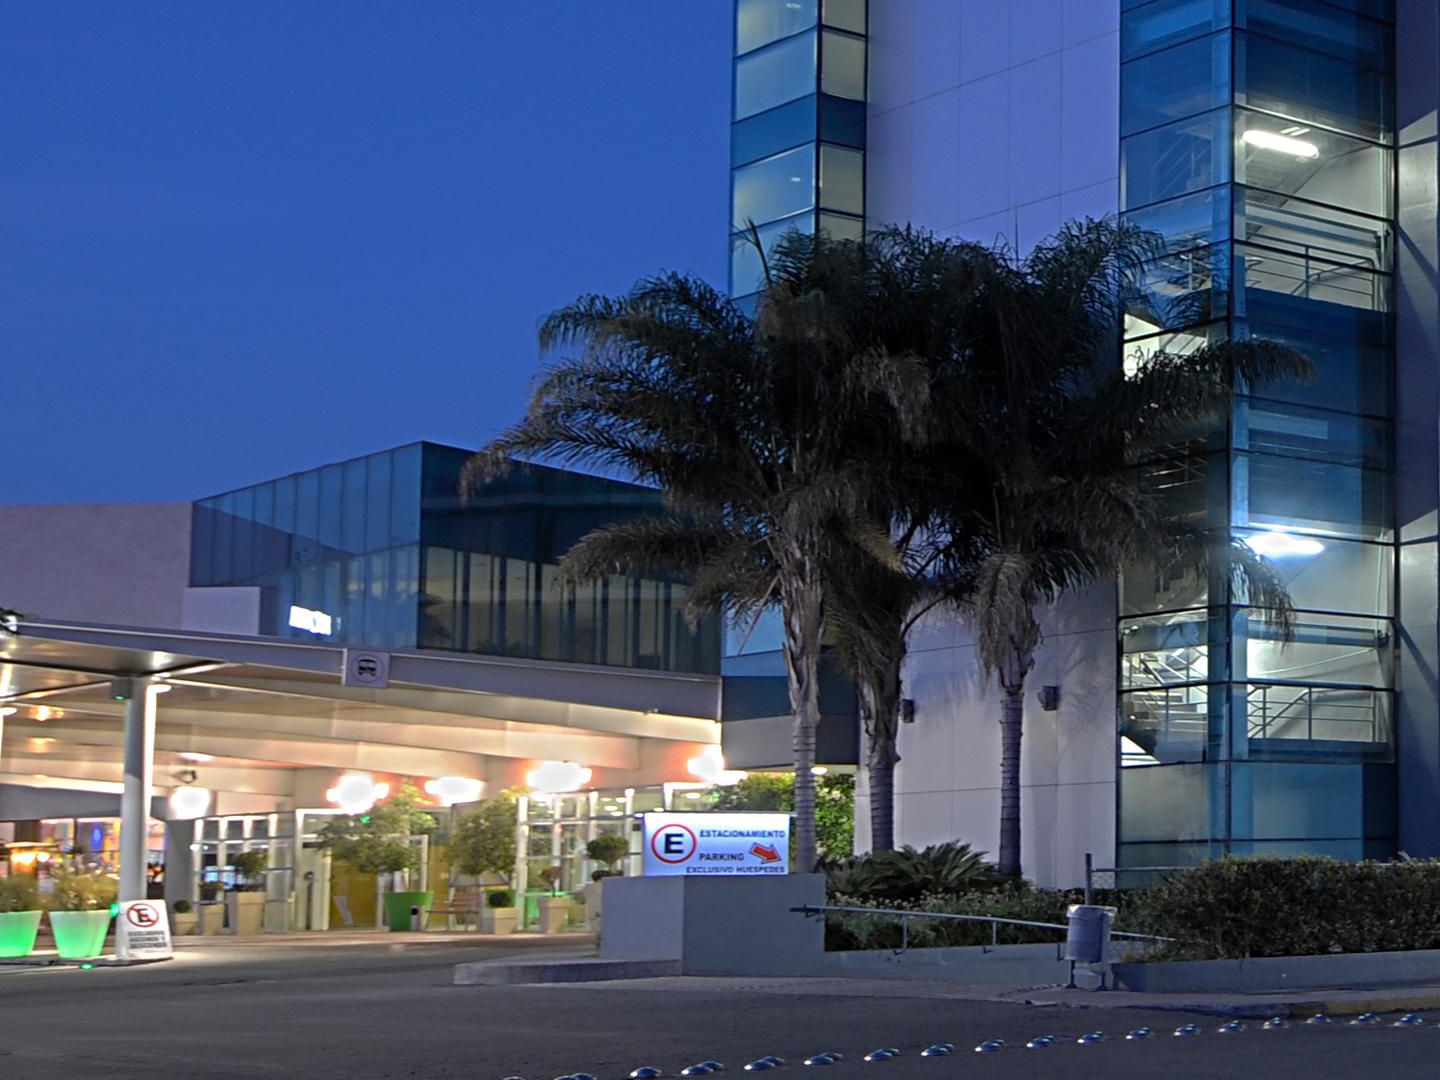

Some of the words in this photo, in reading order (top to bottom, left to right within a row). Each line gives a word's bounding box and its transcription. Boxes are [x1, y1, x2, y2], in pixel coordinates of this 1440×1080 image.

[700, 829, 786, 838] ESTACIONAMIENTO
[664, 833, 684, 854] E
[699, 853, 745, 861] PARKING
[686, 866, 734, 874] EXCLUSIVO
[736, 866, 785, 874] HUESPEDES
